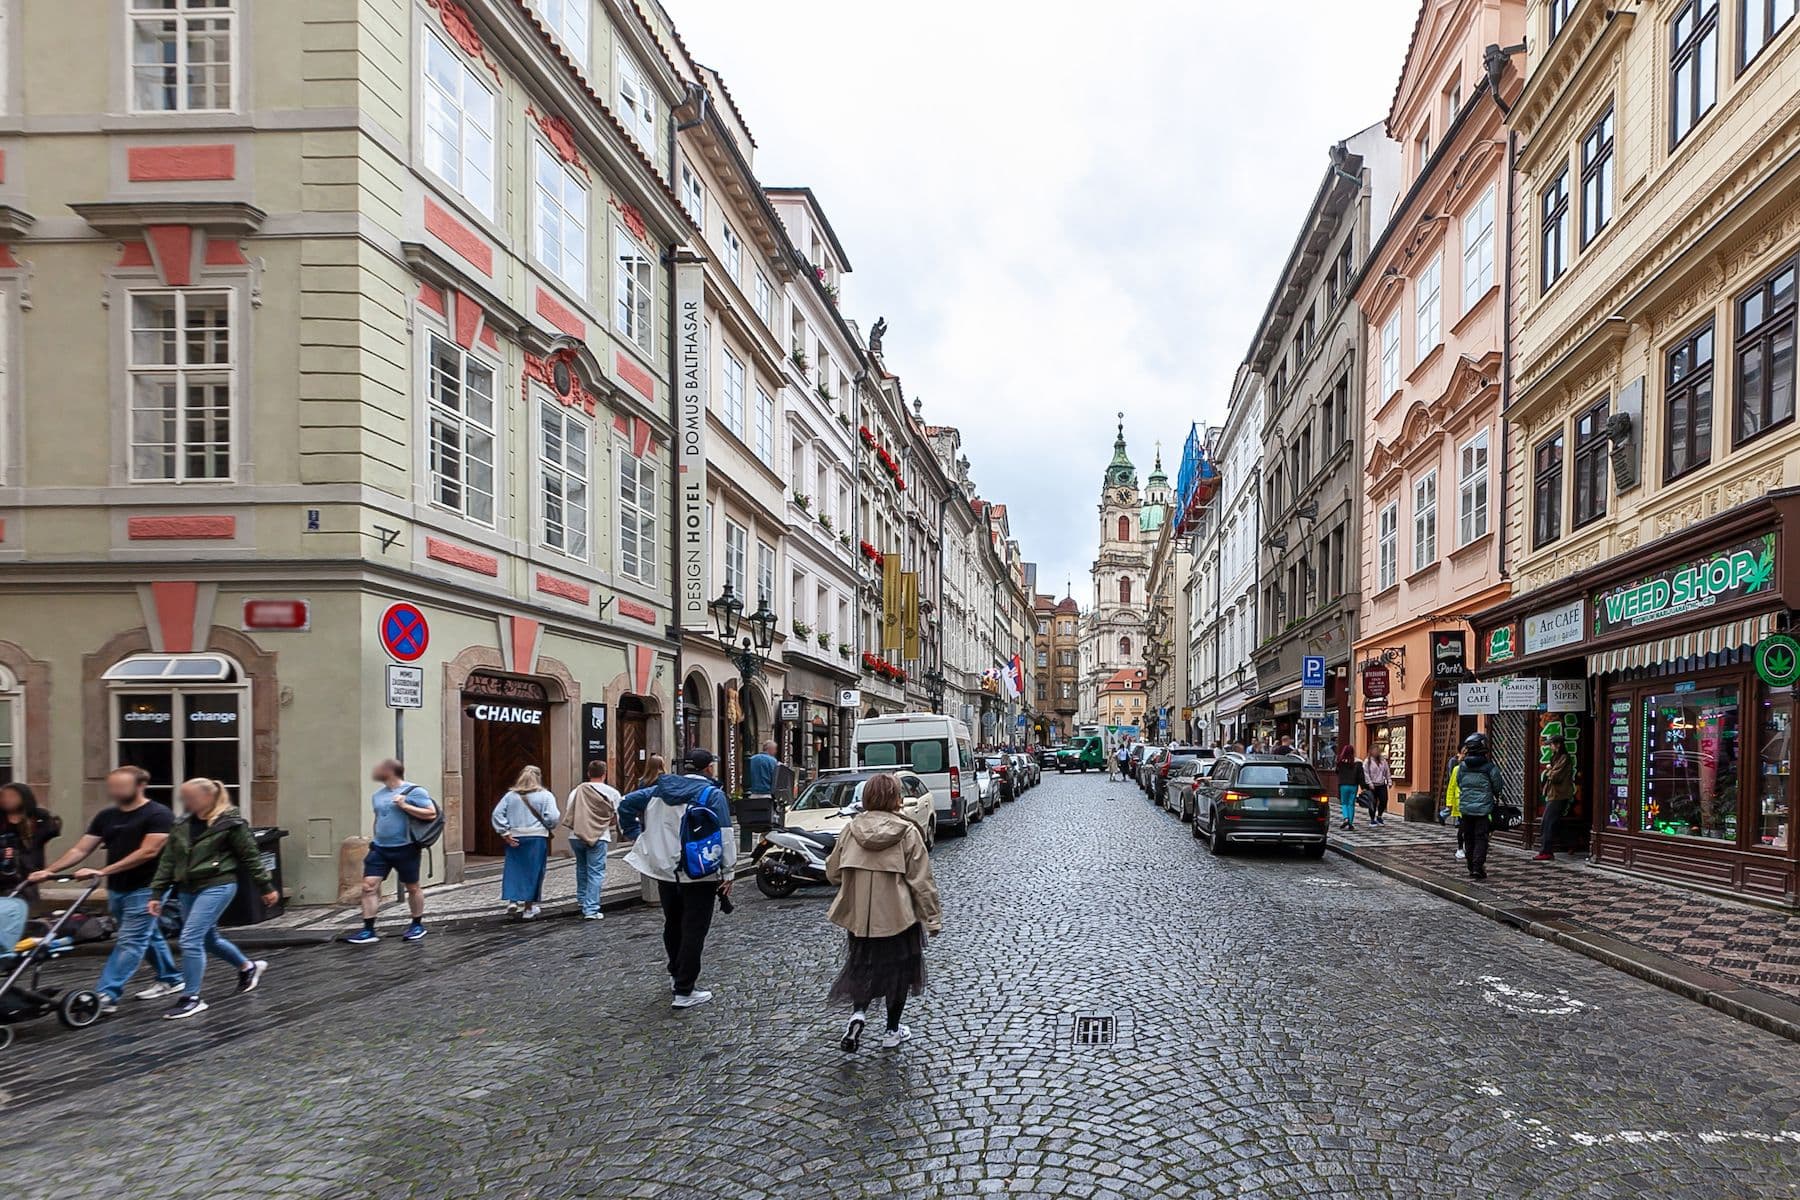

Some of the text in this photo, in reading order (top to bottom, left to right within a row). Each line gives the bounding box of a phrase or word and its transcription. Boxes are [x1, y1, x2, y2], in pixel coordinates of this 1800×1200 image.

[684, 301, 701, 611] DESIGN HOTEL DOMUS BALTHASAR
[1605, 550, 1753, 625] WEED SHOP
[1555, 602, 1580, 628] CAFÉ
[1307, 660, 1320, 677] P
[1467, 693, 1490, 703] CAFÉ
[1469, 686, 1488, 694] ART
[124, 711, 171, 723] change
[190, 711, 237, 723] change
[475, 704, 542, 725] CHANGE
